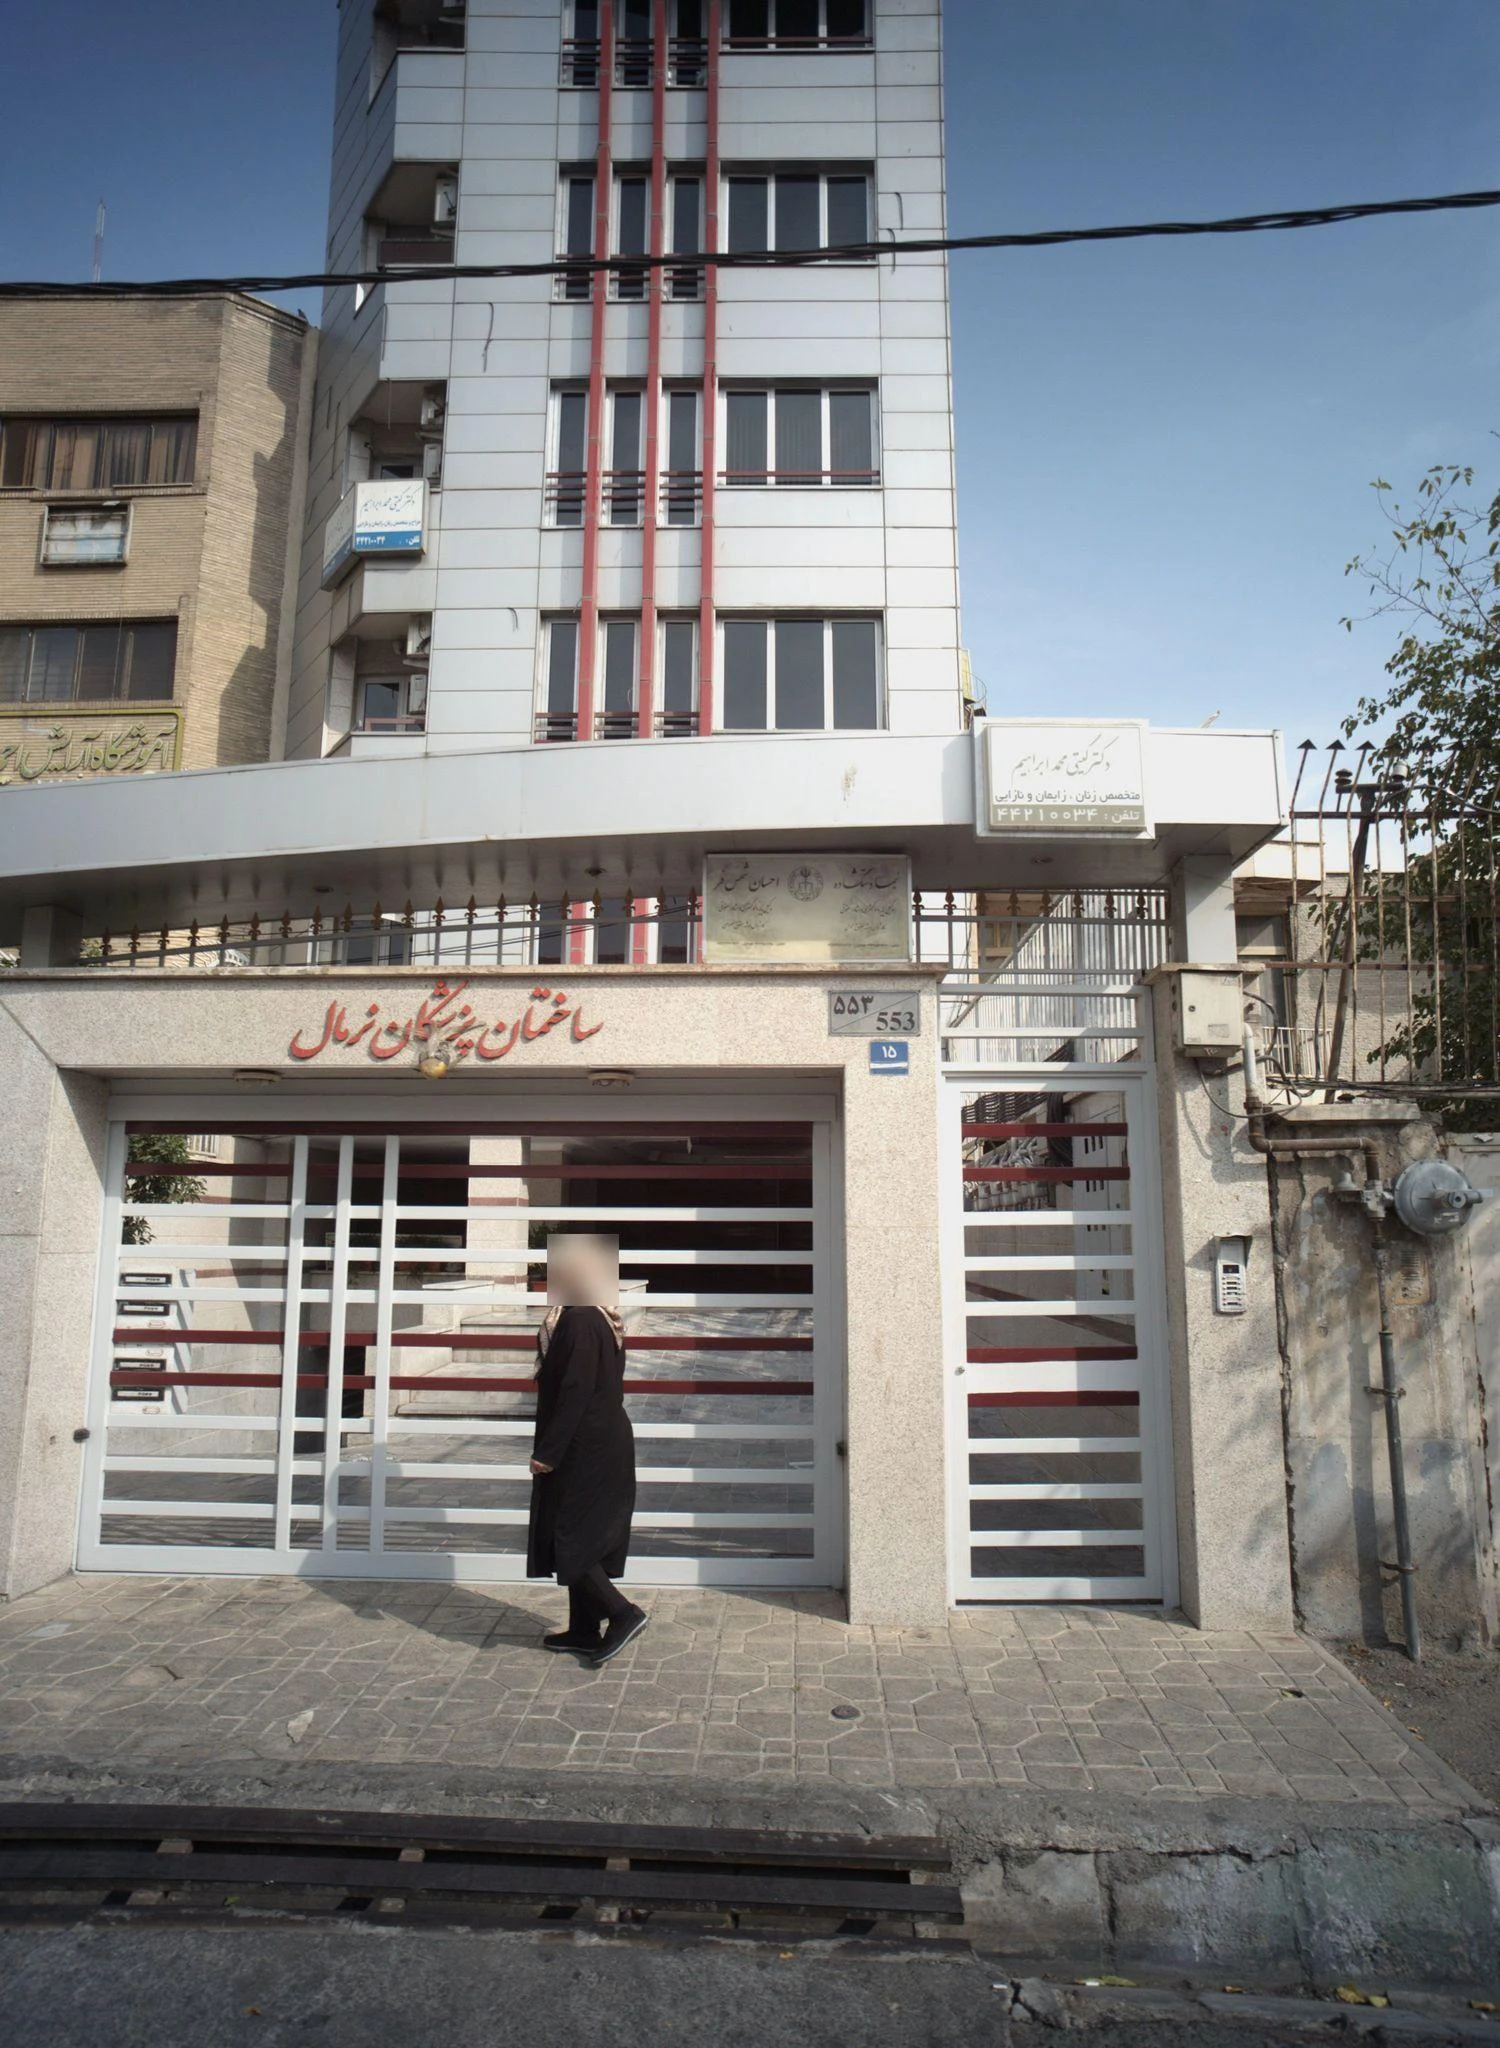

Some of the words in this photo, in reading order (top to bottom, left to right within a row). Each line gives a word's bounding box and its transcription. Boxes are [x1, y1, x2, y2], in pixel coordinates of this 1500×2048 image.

[20, 722, 104, 779] آرایش
[91, 720, 178, 770] آموزشگاه
[1066, 733, 1102, 777] گیتی
[1051, 754, 1068, 772] محمد
[1087, 736, 1120, 775] دکتر
[995, 790, 1024, 803] نازایی
[1027, 793, 1033, 801] و
[1035, 790, 1067, 803] زایمان
[1099, 791, 1141, 803] متخصص
[748, 875, 780, 892] احسان
[833, 995, 874, 1015] ۵۵۳
[289, 999, 379, 1060] نرمال
[369, 979, 478, 1060] پزشکان
[476, 986, 604, 1059] ساختمان
[876, 1011, 915, 1031] 553
[881, 1045, 897, 1058] ۱۵
